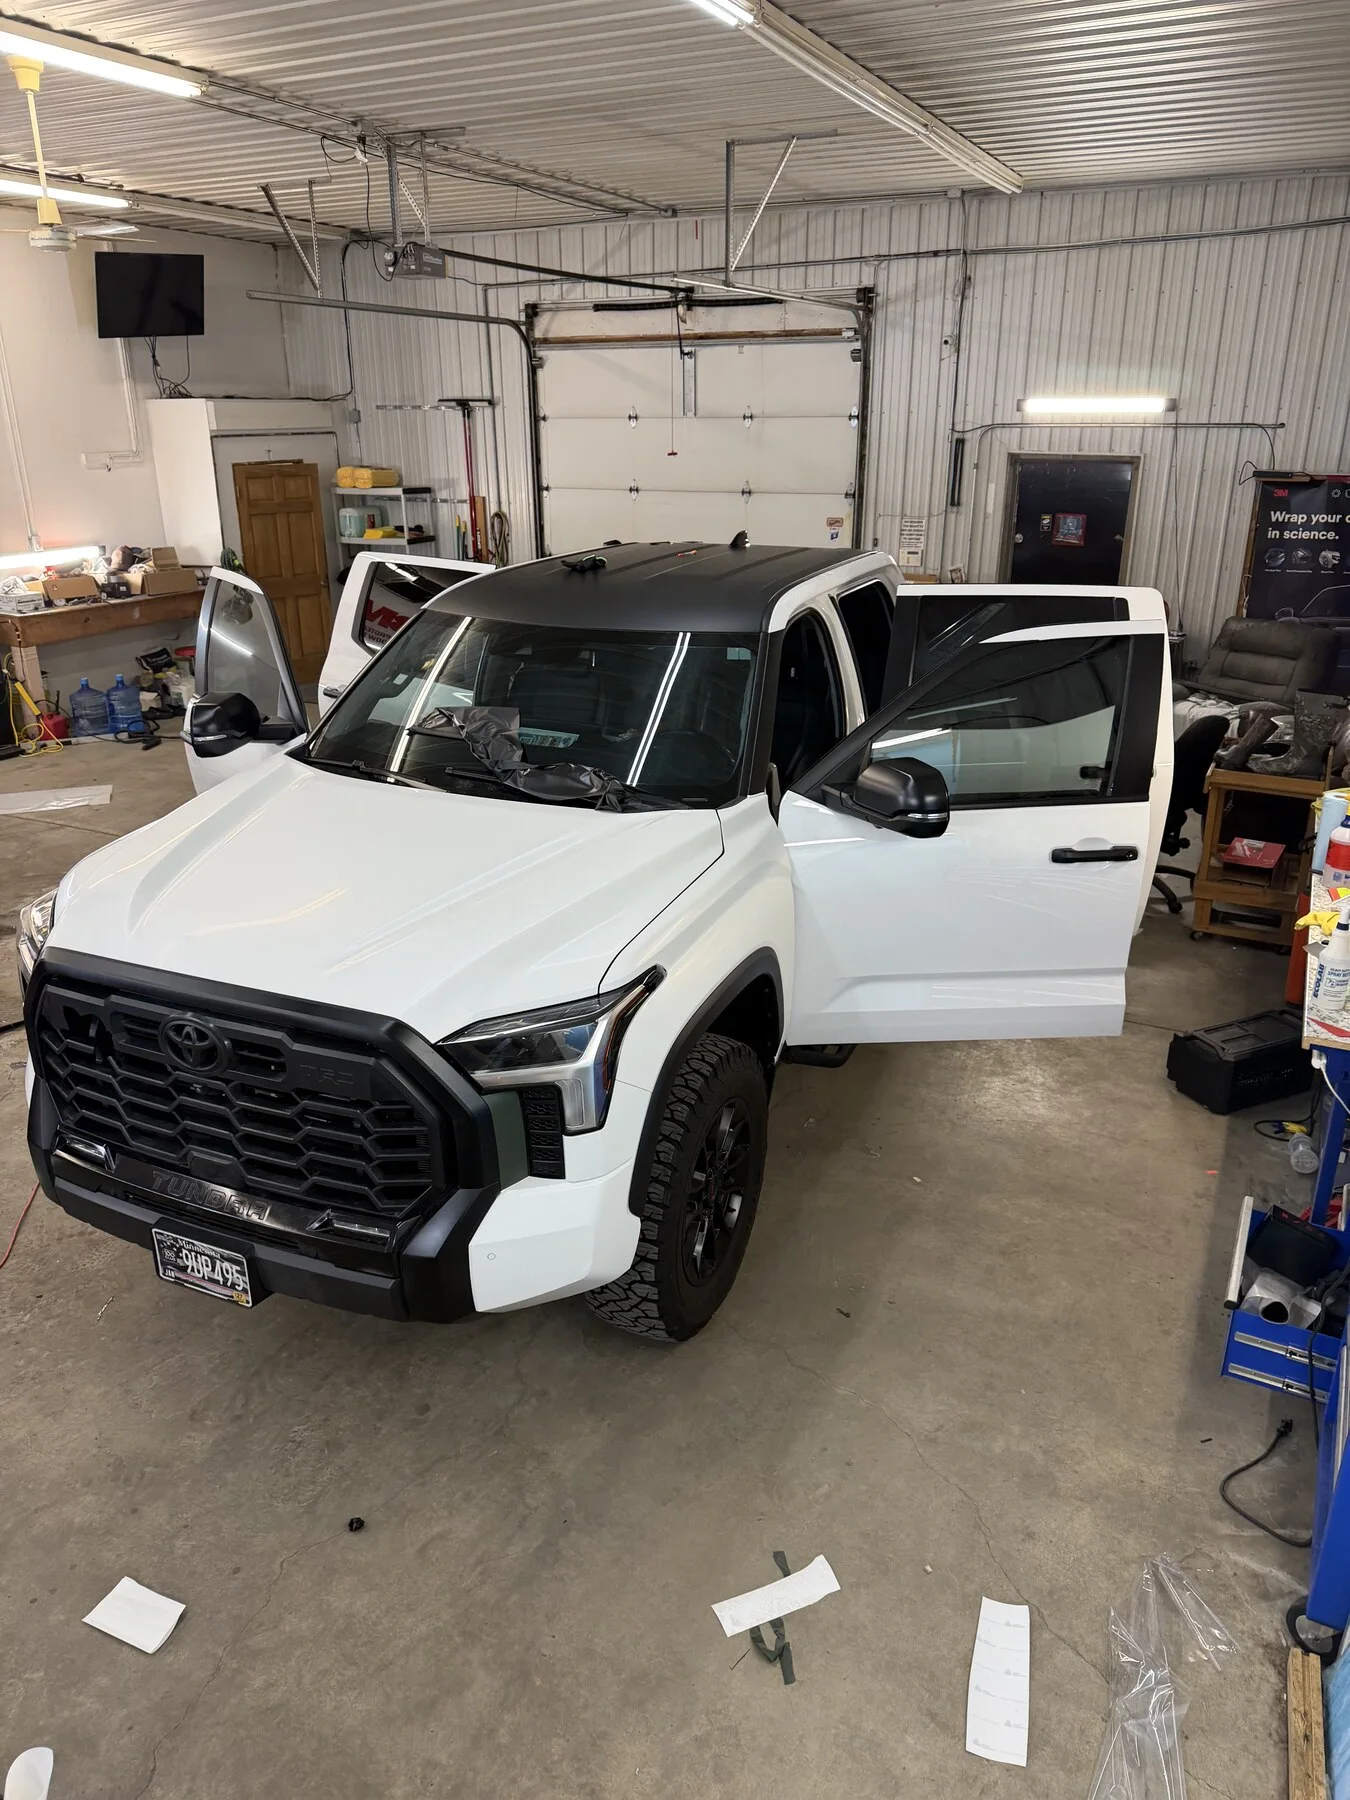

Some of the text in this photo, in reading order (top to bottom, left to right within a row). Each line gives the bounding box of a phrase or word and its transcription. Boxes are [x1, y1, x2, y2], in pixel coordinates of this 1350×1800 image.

[1273, 489, 1288, 497] 3M
[1270, 511, 1307, 525] Wrap
[1311, 514, 1342, 525] your
[1267, 527, 1340, 540] in science.
[1313, 964, 1324, 998] ECOLAB
[151, 1170, 271, 1221] TUNDRA
[177, 1239, 221, 1259] Minnesota
[181, 1248, 244, 1291] 9UP495
